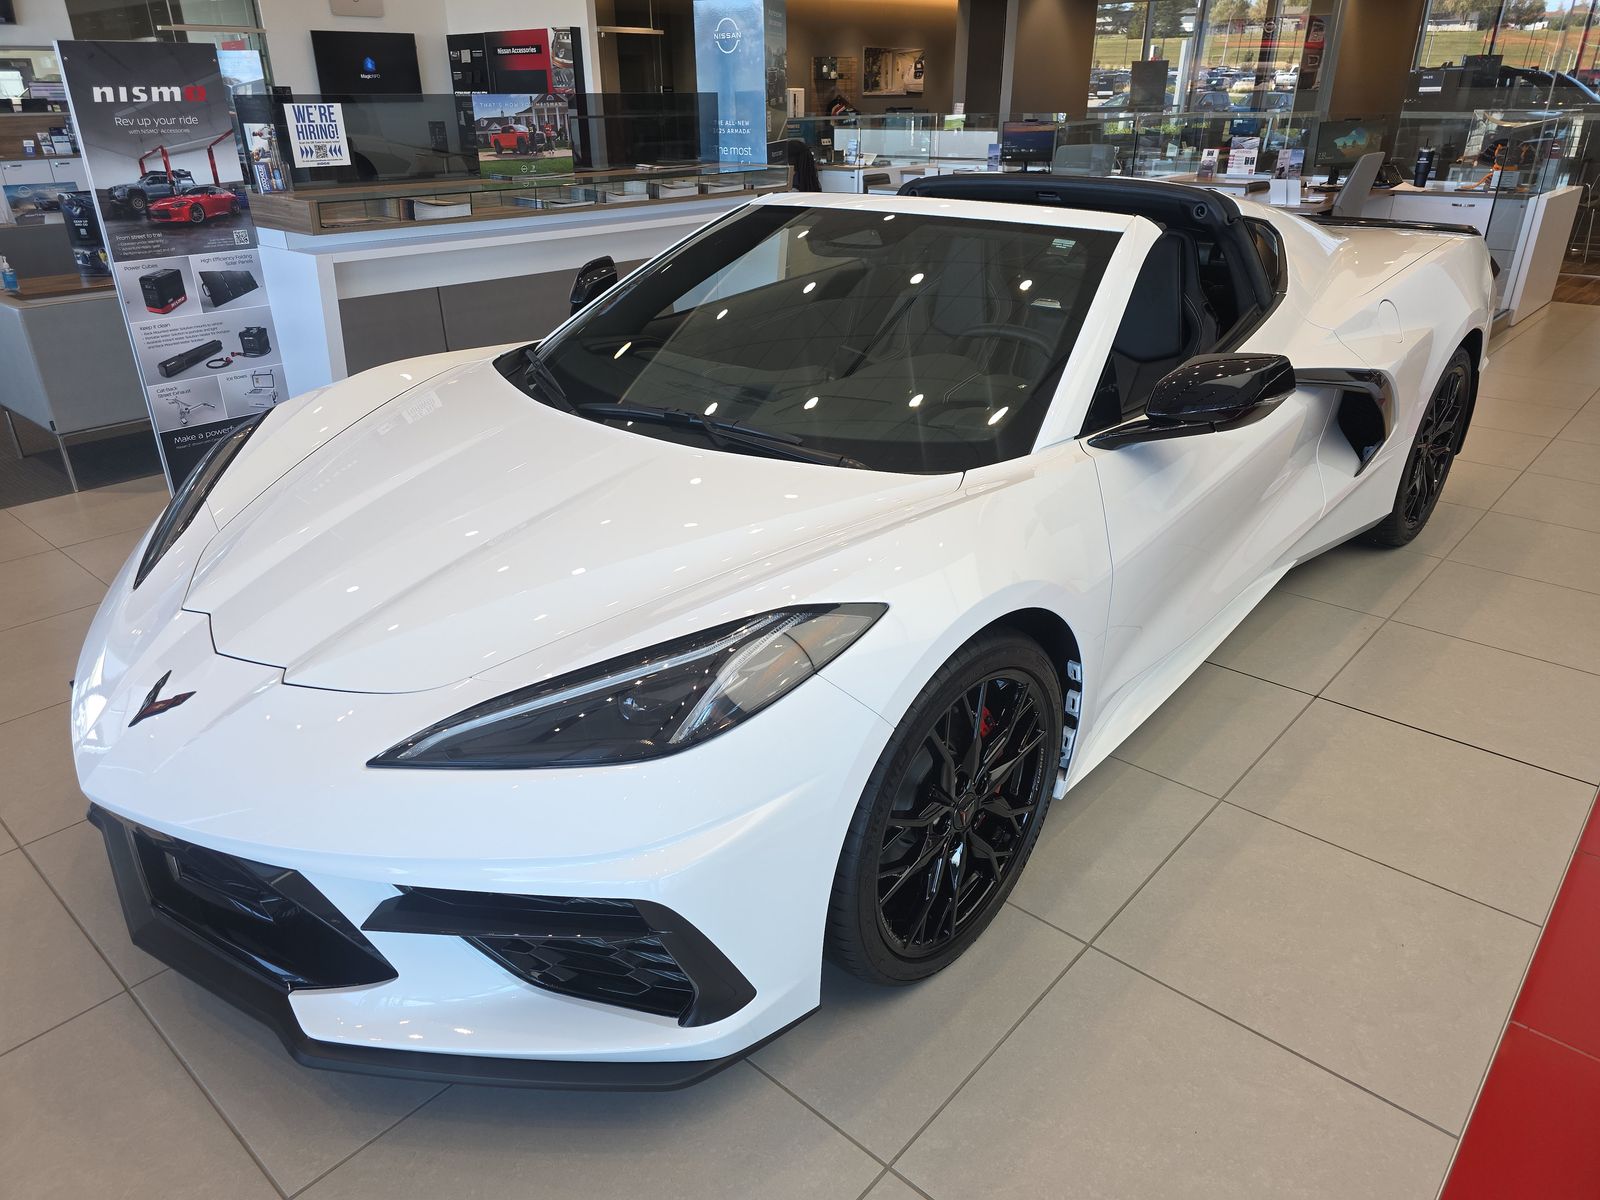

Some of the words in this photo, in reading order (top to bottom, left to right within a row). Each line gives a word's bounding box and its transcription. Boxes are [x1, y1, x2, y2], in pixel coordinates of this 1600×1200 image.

[713, 32, 742, 40] NISSAN
[511, 46, 537, 54] Accessories
[92, 85, 207, 103] nismo
[292, 104, 337, 123] WE'RE
[114, 116, 135, 126] Rev
[137, 117, 151, 127] up
[153, 116, 177, 128] your
[178, 115, 200, 125] ride
[295, 123, 340, 140] HIRING!
[729, 146, 753, 156] most
[157, 391, 172, 399] Street
[174, 433, 196, 443] Make
[206, 425, 234, 438] powerf
